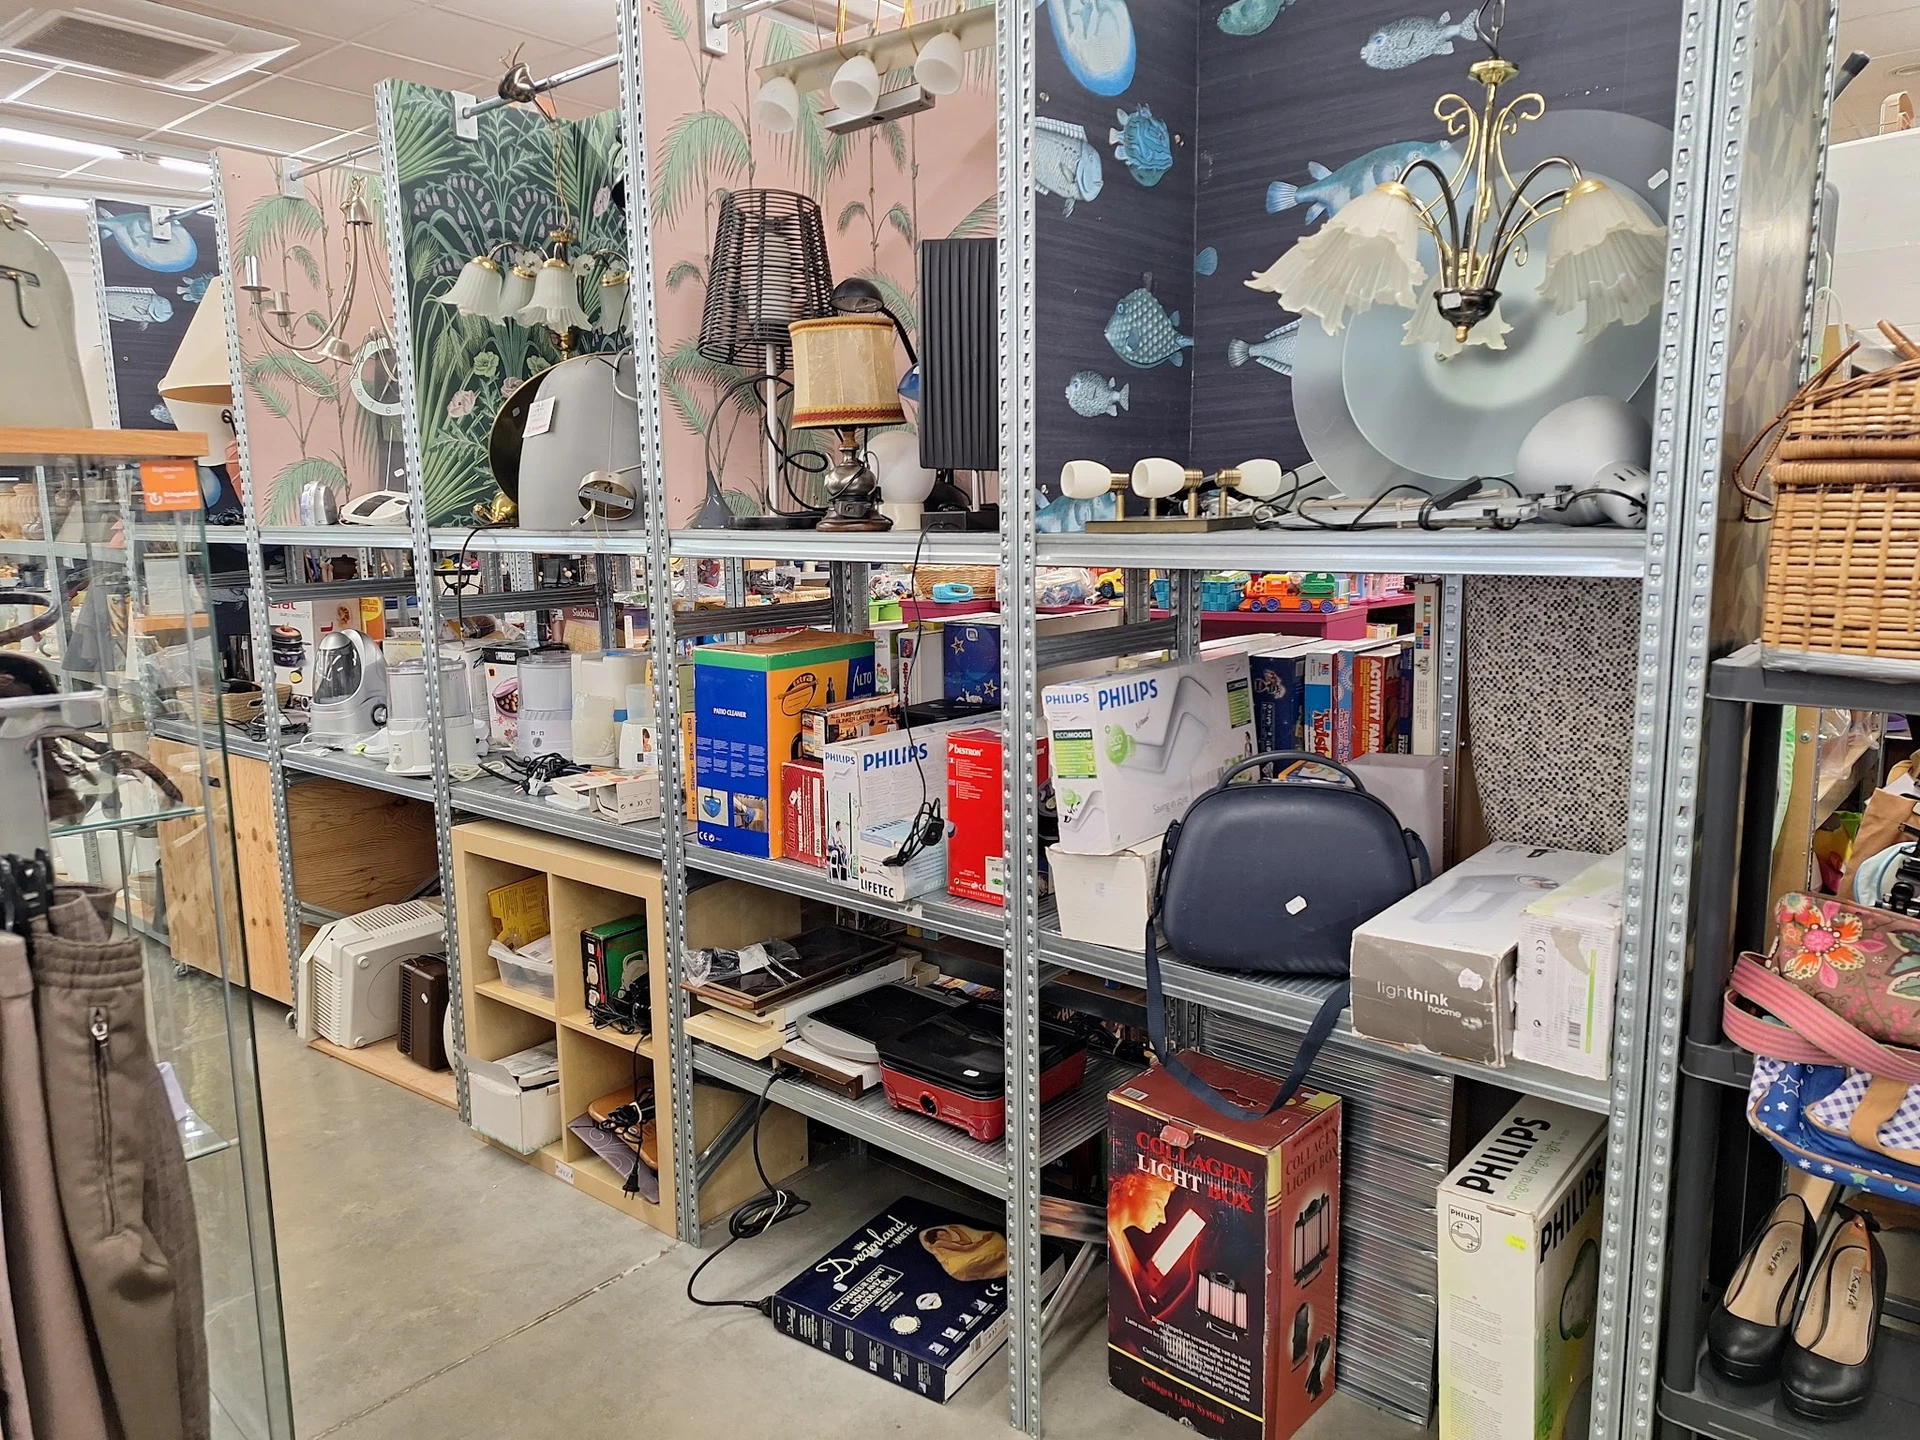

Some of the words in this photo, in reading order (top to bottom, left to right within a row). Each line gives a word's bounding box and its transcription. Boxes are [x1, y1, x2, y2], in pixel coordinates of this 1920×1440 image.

[357, 388, 362, 397] 8
[369, 401, 374, 409] 7
[385, 406, 392, 414] 6
[572, 608, 596, 618] Sudoku
[853, 665, 872, 693] ALTO
[1322, 663, 1330, 676] MB
[1045, 693, 1090, 705] PHILIPS
[1098, 678, 1158, 711] PHILIPS
[1369, 659, 1382, 721] ACTIVITY
[713, 707, 727, 716] PATIO
[727, 708, 747, 719] CLEANER
[825, 752, 856, 765] PHILIPS
[863, 743, 928, 772] PHILIPS
[860, 878, 894, 898] LIFETEC
[1377, 981, 1449, 1007] lighthink
[1427, 1004, 1462, 1018] hoome
[1136, 1131, 1254, 1188] COLLAGEN
[1285, 1125, 1339, 1177] COLLAGEN
[1455, 1116, 1552, 1195] PHILIPS
[1136, 1153, 1203, 1193] LIGHT
[1208, 1182, 1254, 1213] BOX
[1286, 1164, 1317, 1196] LIGHT
[1506, 1174, 1531, 1201] original
[1526, 1152, 1550, 1179] bright
[1450, 1208, 1481, 1224] PHILIPS
[1539, 1160, 1604, 1264] PHILIPS
[815, 1214, 907, 1283] Dreamland
[892, 1224, 918, 1245] IMETEC
[832, 1304, 844, 1312] LA
[840, 1279, 868, 1305] CHALEUR
[866, 1267, 885, 1283] DONT
[849, 1290, 869, 1305] VOUS
[866, 1278, 883, 1292] AVEZ
[850, 1284, 883, 1313] TOUJOURS
[1141, 1376, 1174, 1399] Collagen
[1174, 1389, 1195, 1411] Light
[1196, 1404, 1226, 1424] System
